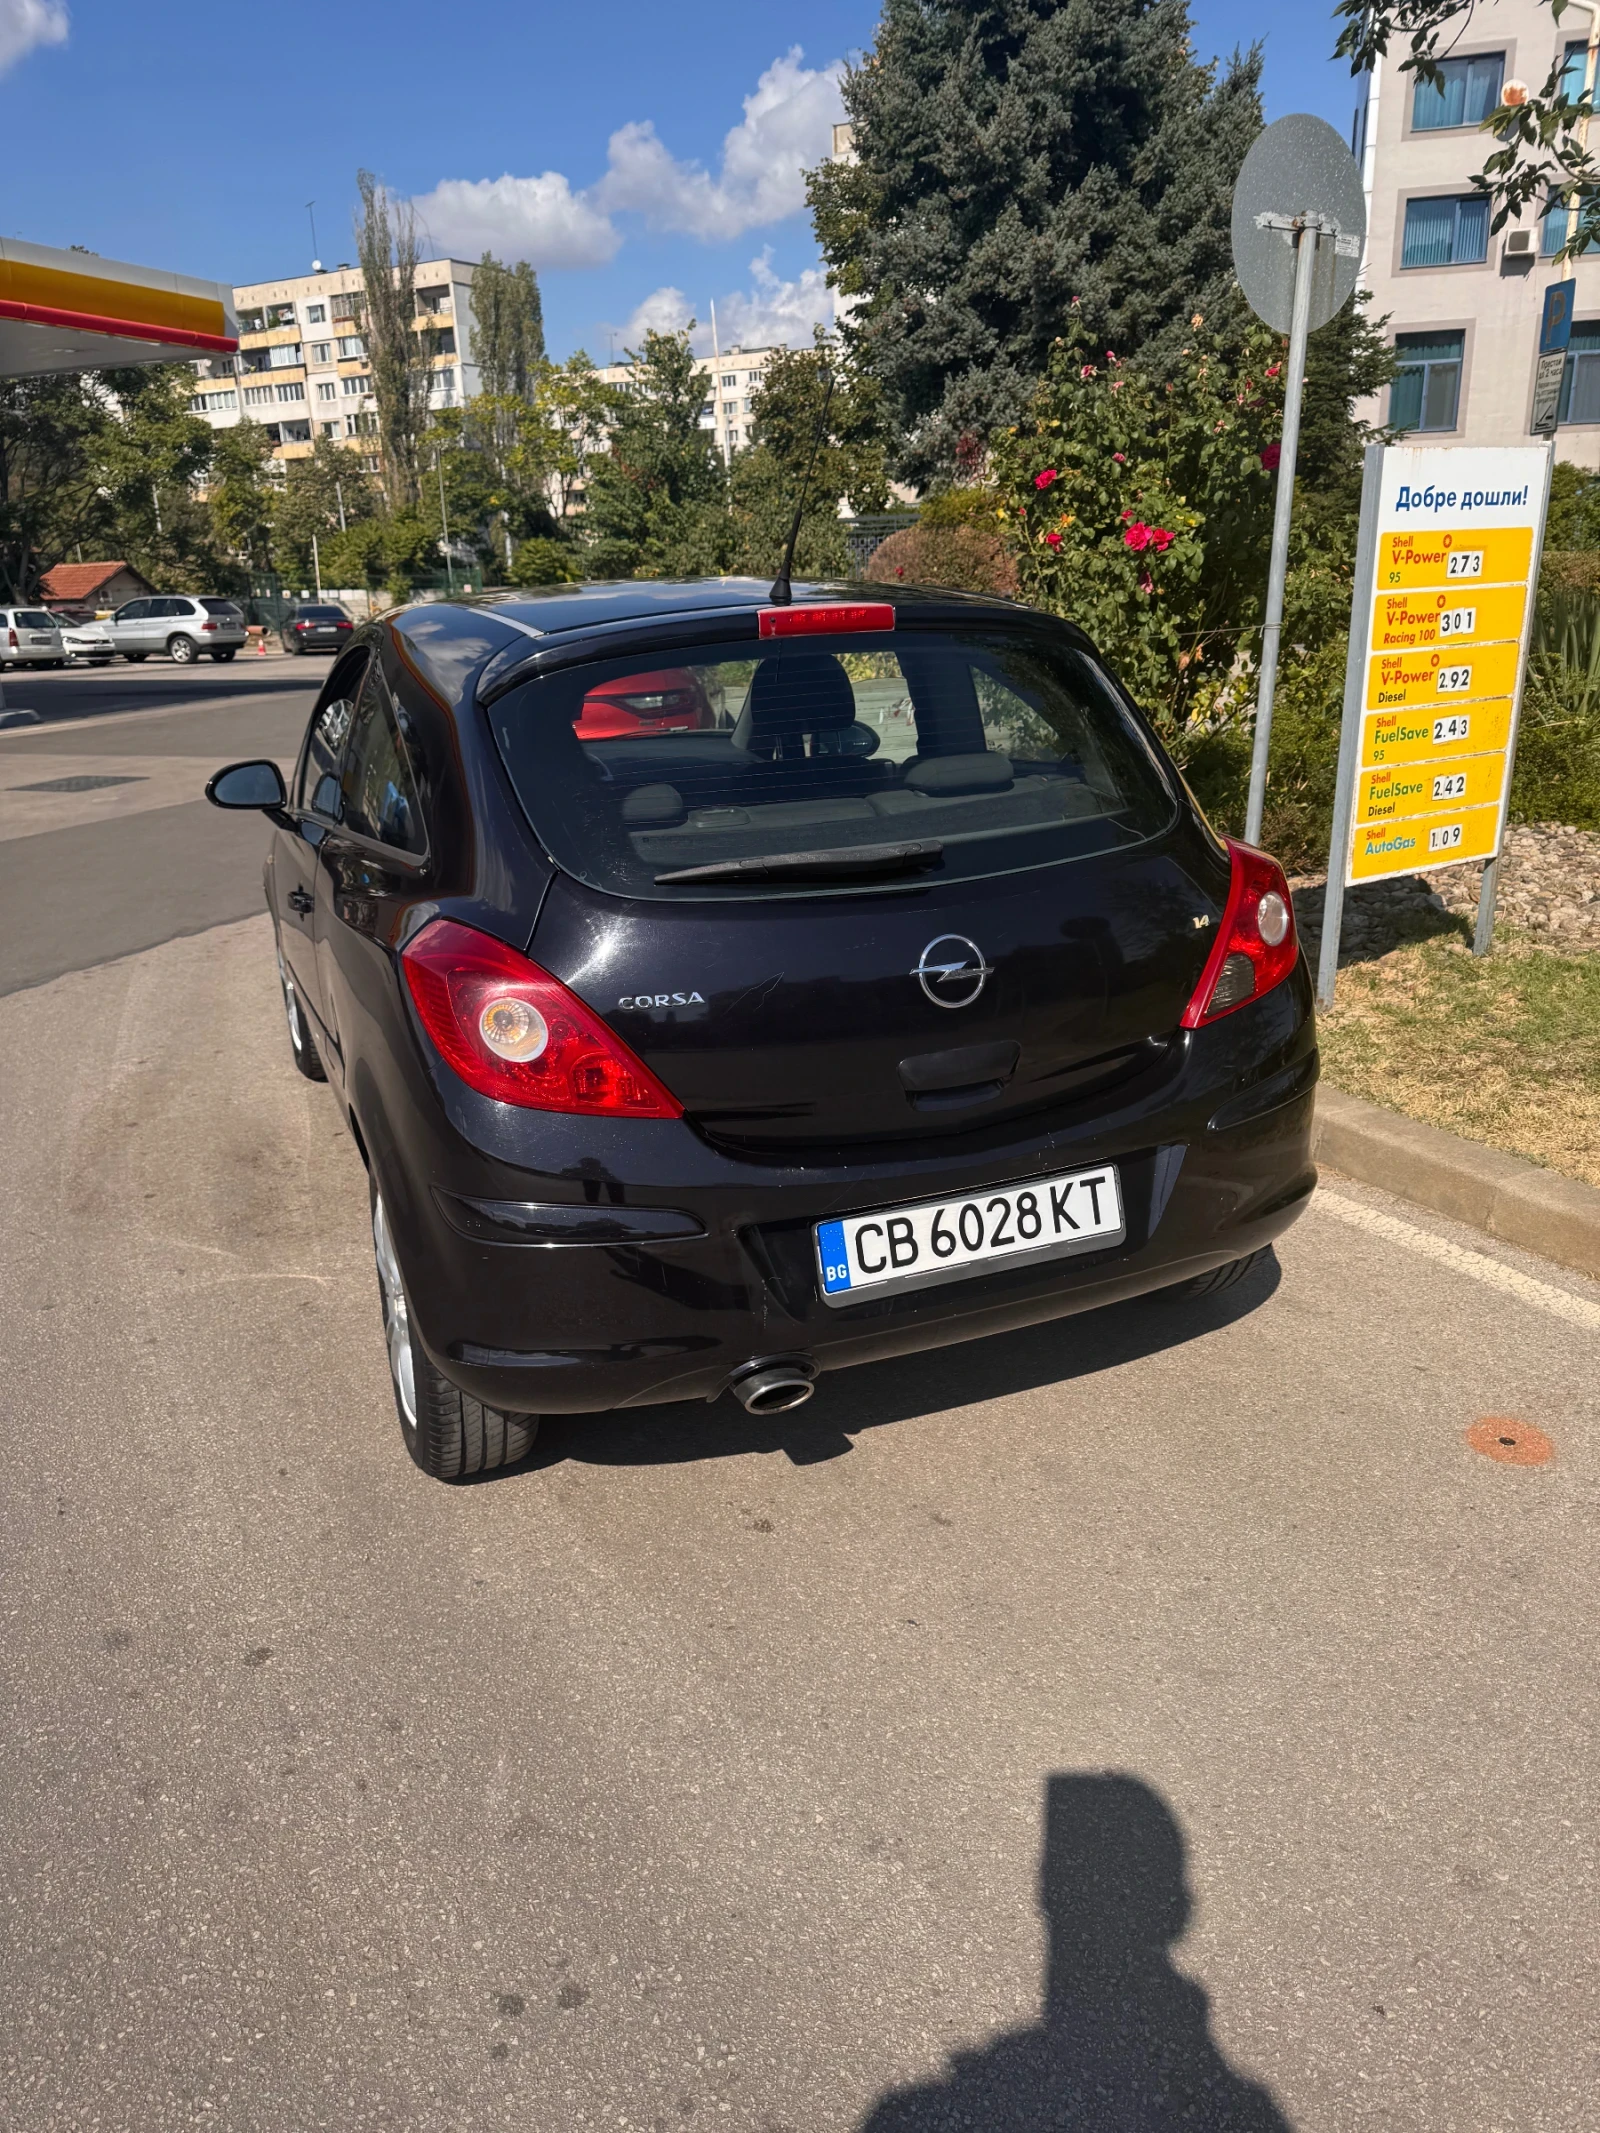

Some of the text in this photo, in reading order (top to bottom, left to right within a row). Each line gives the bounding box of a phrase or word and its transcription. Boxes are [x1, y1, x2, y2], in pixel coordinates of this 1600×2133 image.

[1546, 291, 1565, 343] P
[1545, 368, 1550, 378] 2
[1395, 485, 1528, 513] Добре дошли!
[1392, 536, 1413, 548] Shell
[1392, 550, 1446, 565] V-Power
[1389, 571, 1401, 583] 95
[1387, 597, 1407, 609] Shell
[1386, 610, 1440, 626] V-Power
[1383, 629, 1436, 645] Racing 100
[1381, 657, 1402, 669] Shell
[1381, 670, 1434, 686] V-Power
[1378, 689, 1406, 703] Diesel
[1376, 716, 1396, 728] Shell
[1374, 727, 1429, 744] FuelSave
[1373, 750, 1385, 761] 95
[1371, 772, 1391, 784] Shell
[1369, 782, 1423, 800] FuelSave
[1368, 803, 1395, 817] Diesel
[1366, 828, 1386, 840] Shell
[1365, 838, 1416, 856] AutoGas
[618, 991, 706, 1010] CORSA
[854, 1176, 1106, 1274] CB 6028 KT
[826, 1264, 847, 1282] BG
